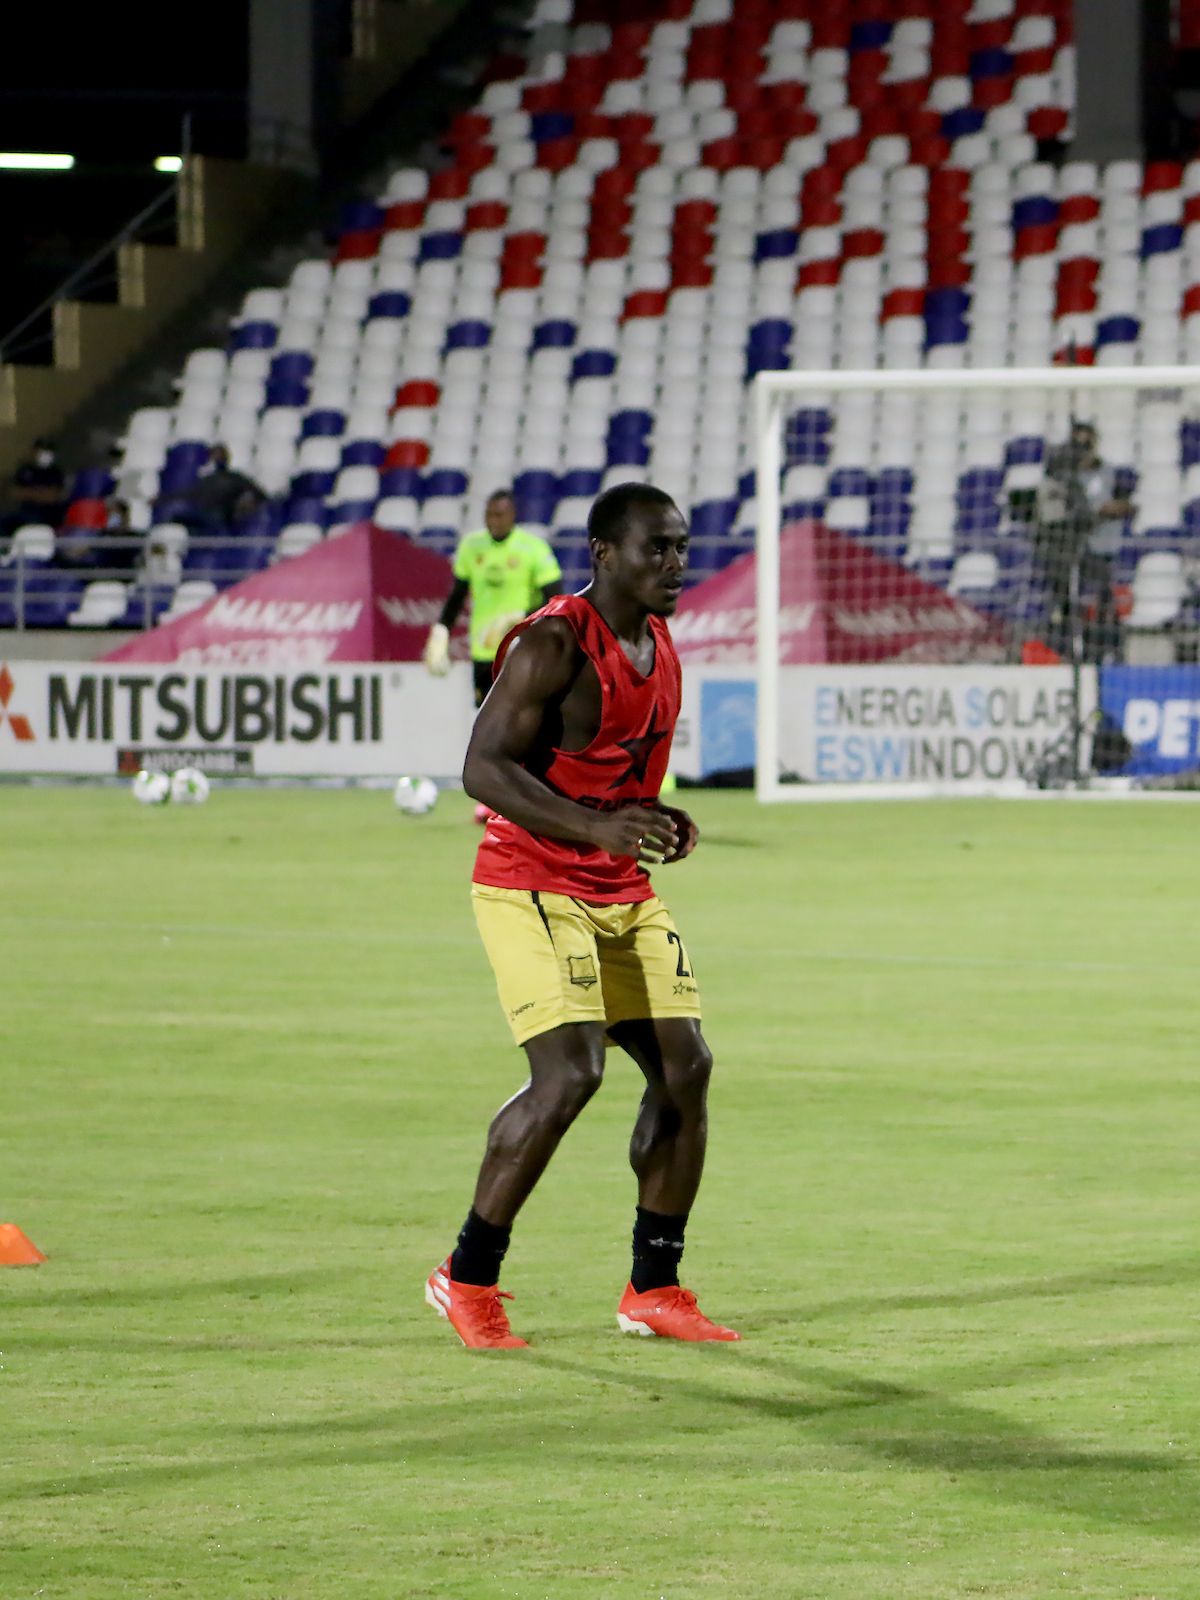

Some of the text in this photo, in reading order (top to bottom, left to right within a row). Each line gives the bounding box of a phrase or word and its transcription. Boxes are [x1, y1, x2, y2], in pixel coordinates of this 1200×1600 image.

[48, 674, 382, 742] MITSUBISHI
[815, 686, 1079, 728] ENERGIA SOLAR
[815, 735, 1076, 780] ESWINDOW
[667, 931, 694, 978] 2
